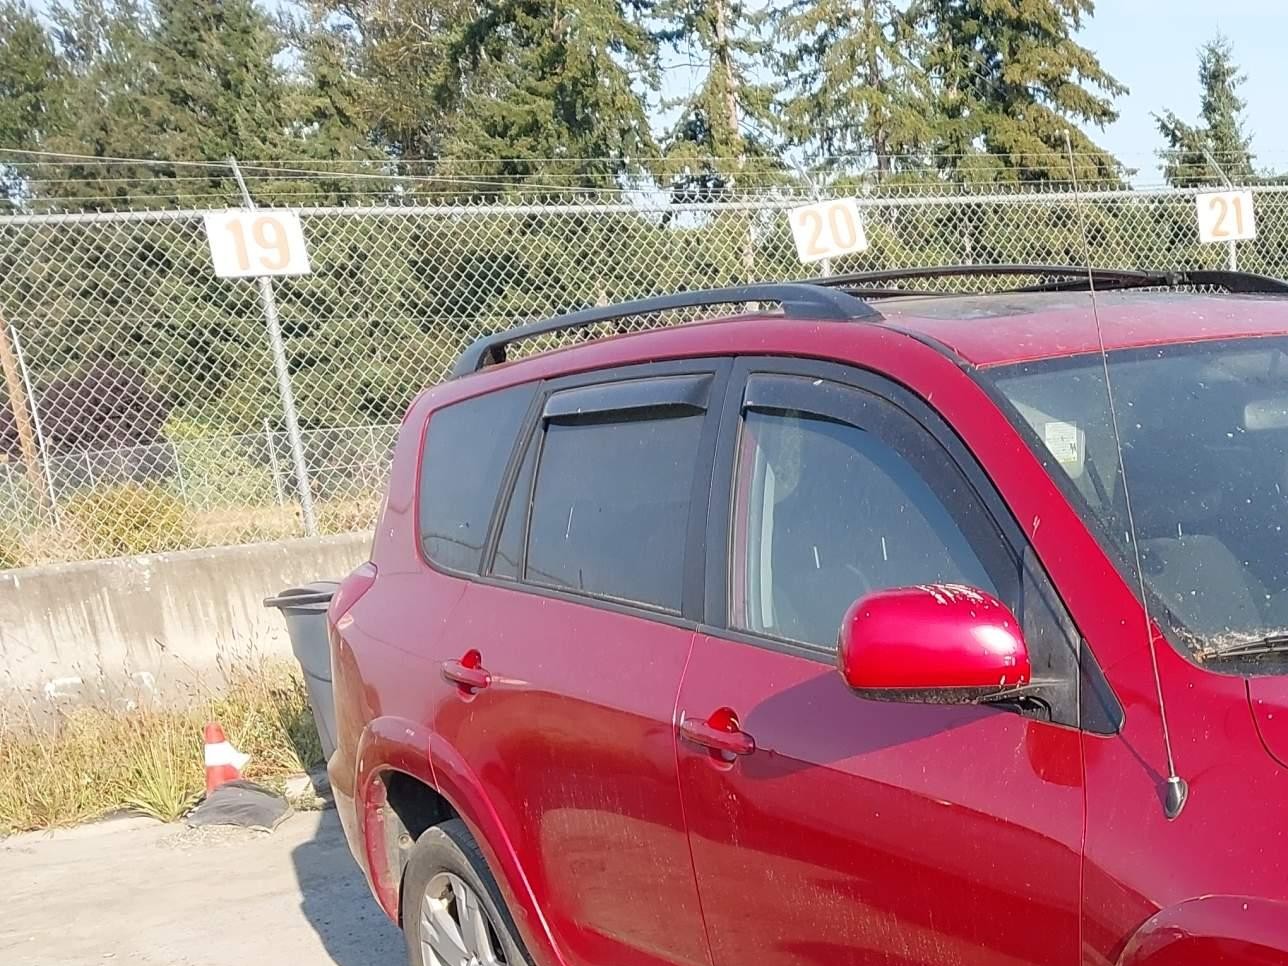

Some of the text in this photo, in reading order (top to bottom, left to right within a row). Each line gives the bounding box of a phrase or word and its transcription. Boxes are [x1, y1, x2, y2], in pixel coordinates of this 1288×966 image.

[226, 216, 291, 271] 19
[798, 203, 857, 256] 20
[1209, 196, 1244, 238] 21
